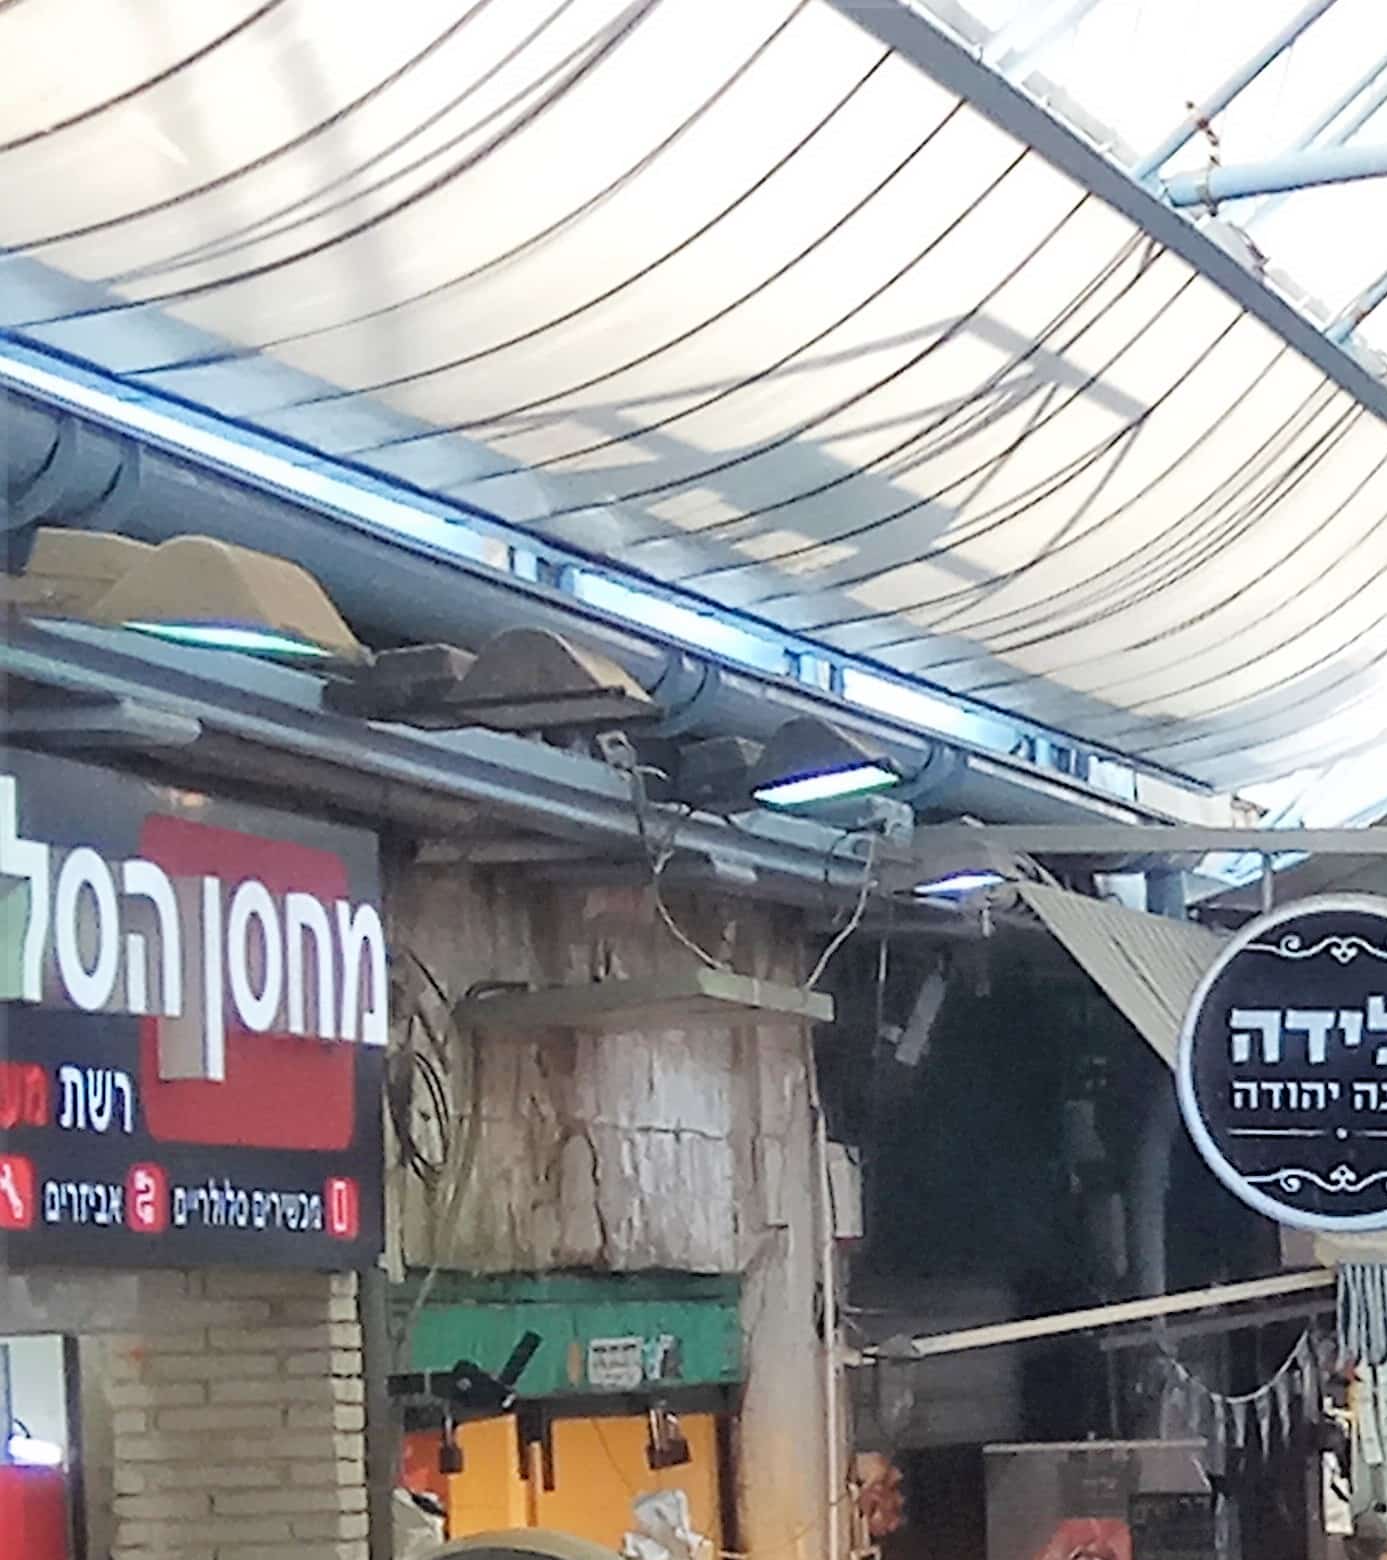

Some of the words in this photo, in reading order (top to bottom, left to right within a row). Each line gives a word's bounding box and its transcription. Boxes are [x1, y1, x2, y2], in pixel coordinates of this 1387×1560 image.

[204, 875, 389, 1082] מחסן
[58, 1065, 134, 1133] רשת
[1232, 1081, 1339, 1111] יהודה
[45, 1181, 124, 1226] אביזרים
